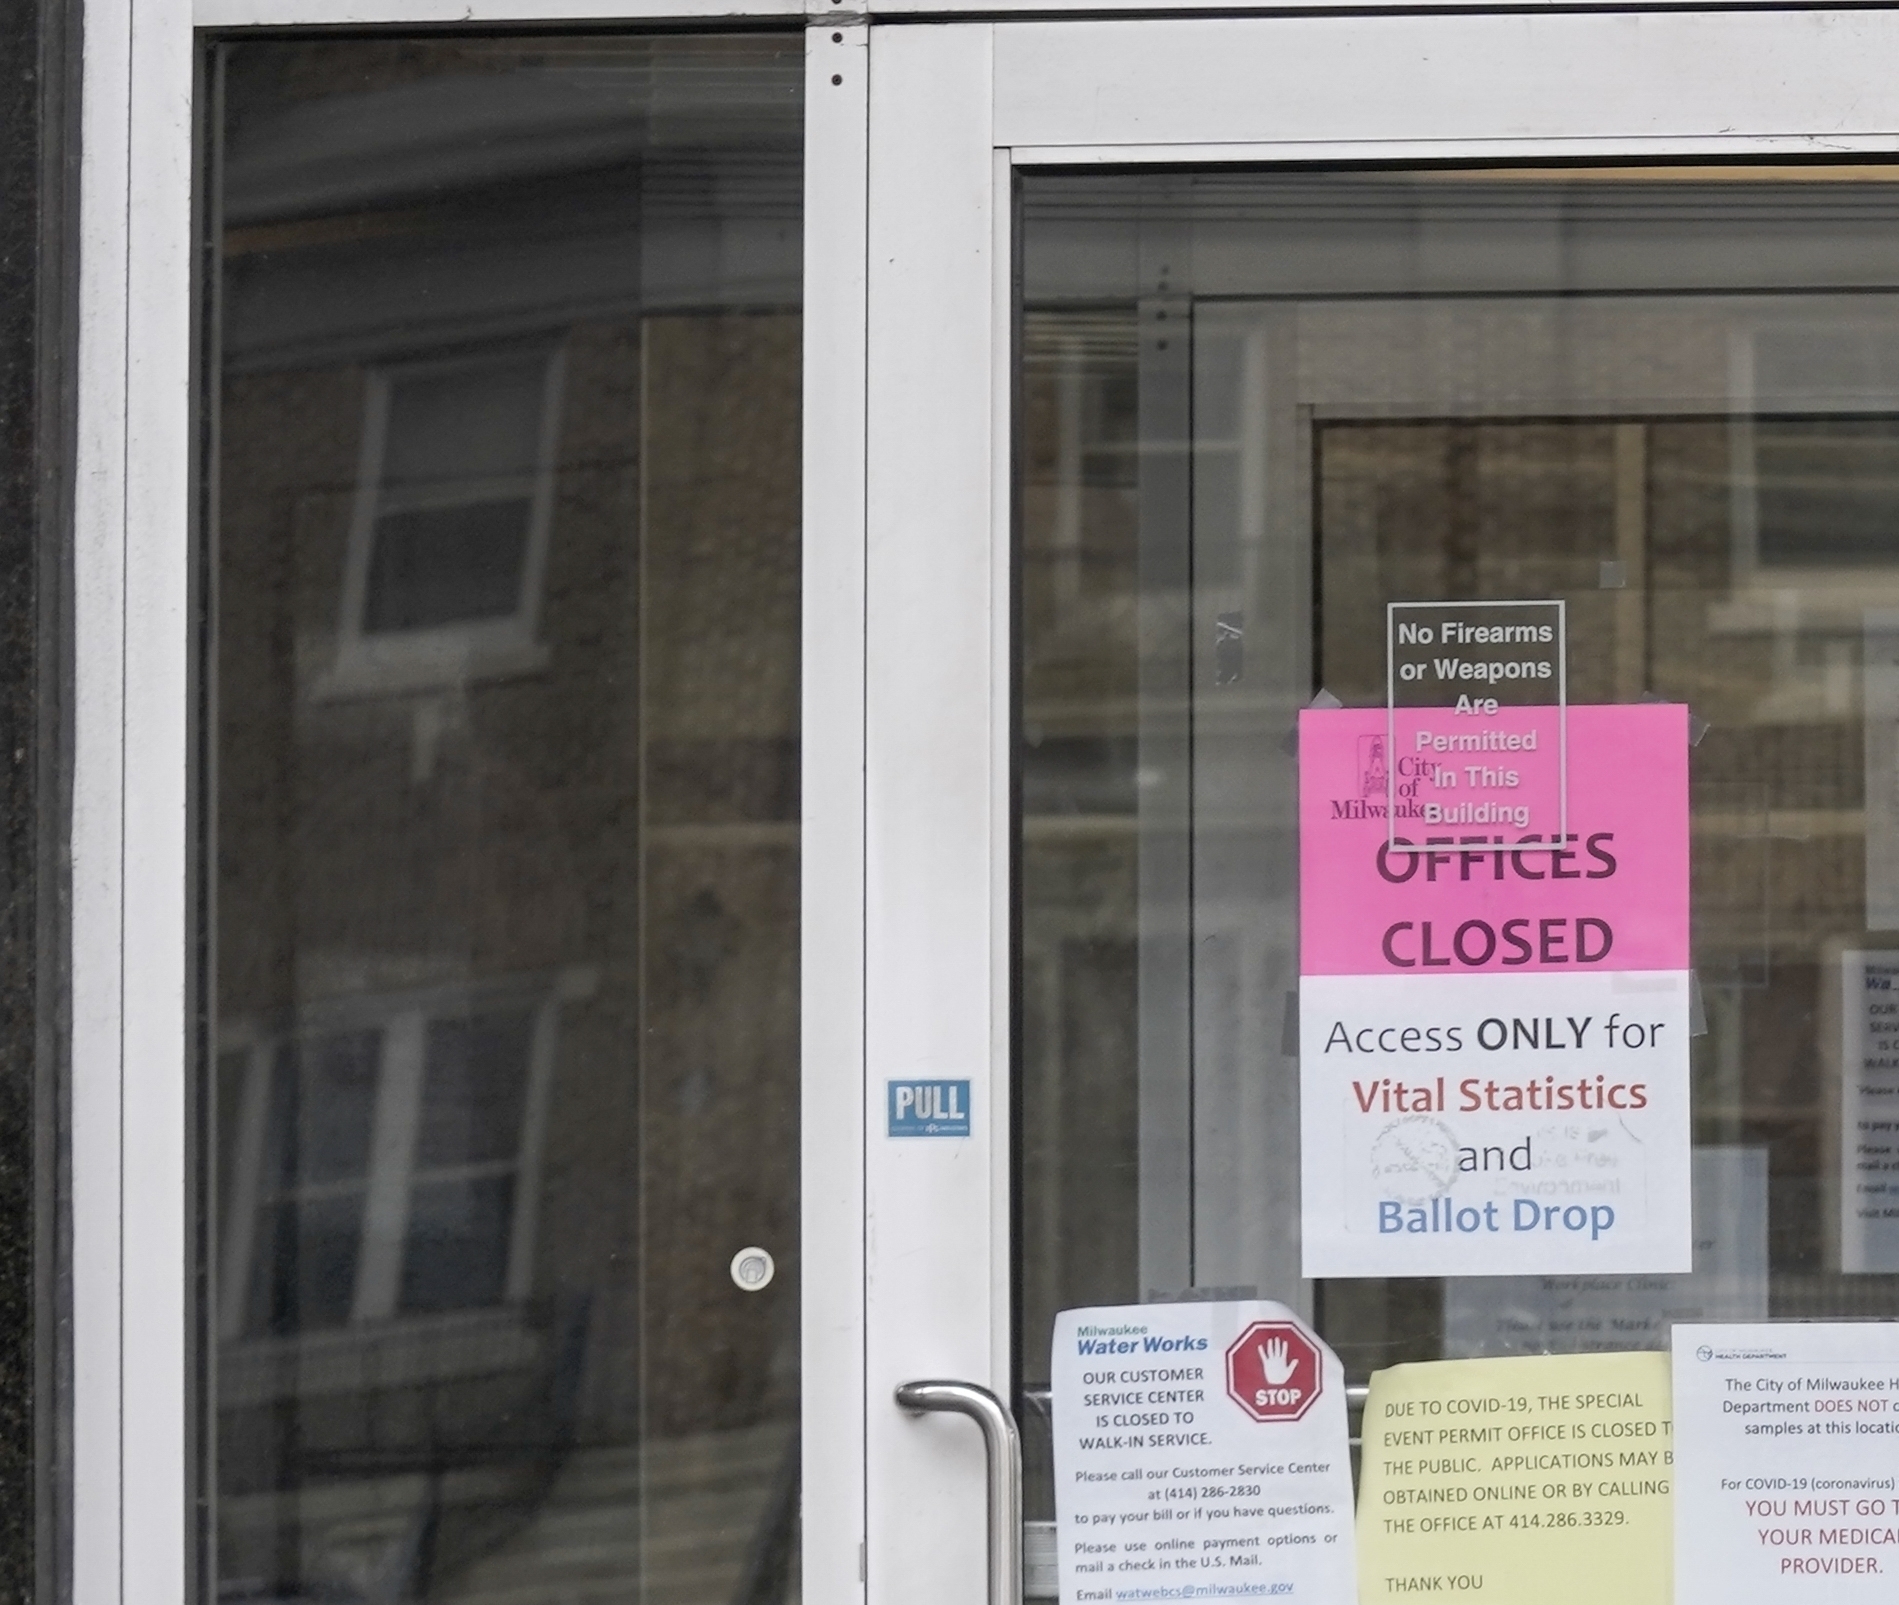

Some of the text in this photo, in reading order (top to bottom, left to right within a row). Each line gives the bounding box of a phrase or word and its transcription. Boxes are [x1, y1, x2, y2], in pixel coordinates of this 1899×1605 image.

[1399, 622, 1553, 644] No Firearms
[1400, 659, 1551, 684] or Weapons
[1453, 695, 1500, 716] Are
[1417, 730, 1536, 751] Permitted
[1398, 756, 1442, 782] City
[1435, 766, 1519, 787] In This
[1398, 778, 1421, 798] of
[1425, 802, 1529, 827] Building
[1377, 833, 1616, 883] OFFICES
[1382, 918, 1613, 967] CLOSED
[1325, 1014, 1665, 1053] Access ONLY for
[896, 1086, 964, 1119] PULL
[1353, 1075, 1647, 1112] Vital Statistics
[1458, 1136, 1531, 1171] and
[1379, 1198, 1614, 1240] Ballot Drop
[1077, 1325, 1149, 1337] Milwaukee
[1078, 1336, 1207, 1355] Water Works
[1083, 1368, 1203, 1384] OUR CUSTOMER
[1084, 1390, 1204, 1406] SERVICE CENTER
[1256, 1389, 1302, 1406] STOP
[1385, 1393, 1643, 1418] DUE TO COVID-19, THE SPECIAL
[1097, 1412, 1194, 1427] IS CLOSED TO
[1079, 1433, 1212, 1449] WALK-IN SERVICE.
[1385, 1421, 1671, 1446] EVENT PERMIT OFFICE IS CLOSED T
[1384, 1451, 1673, 1475] THE PUBLIC. APPLICATIONS MAY B
[1384, 1480, 1669, 1504] OBTAINED ONLINE OR BY CALLING
[1746, 1500, 1786, 1516] YOU
[1795, 1500, 1850, 1516] MUST
[1856, 1499, 1885, 1515] GO
[1384, 1511, 1629, 1533] THE OFFICE AT 414.286.3329.
[1758, 1529, 1812, 1545] YOUR
[1782, 1558, 1883, 1574] PROVIDER.
[1386, 1575, 1482, 1592] THANK YOU
[1077, 1589, 1112, 1601] Email
